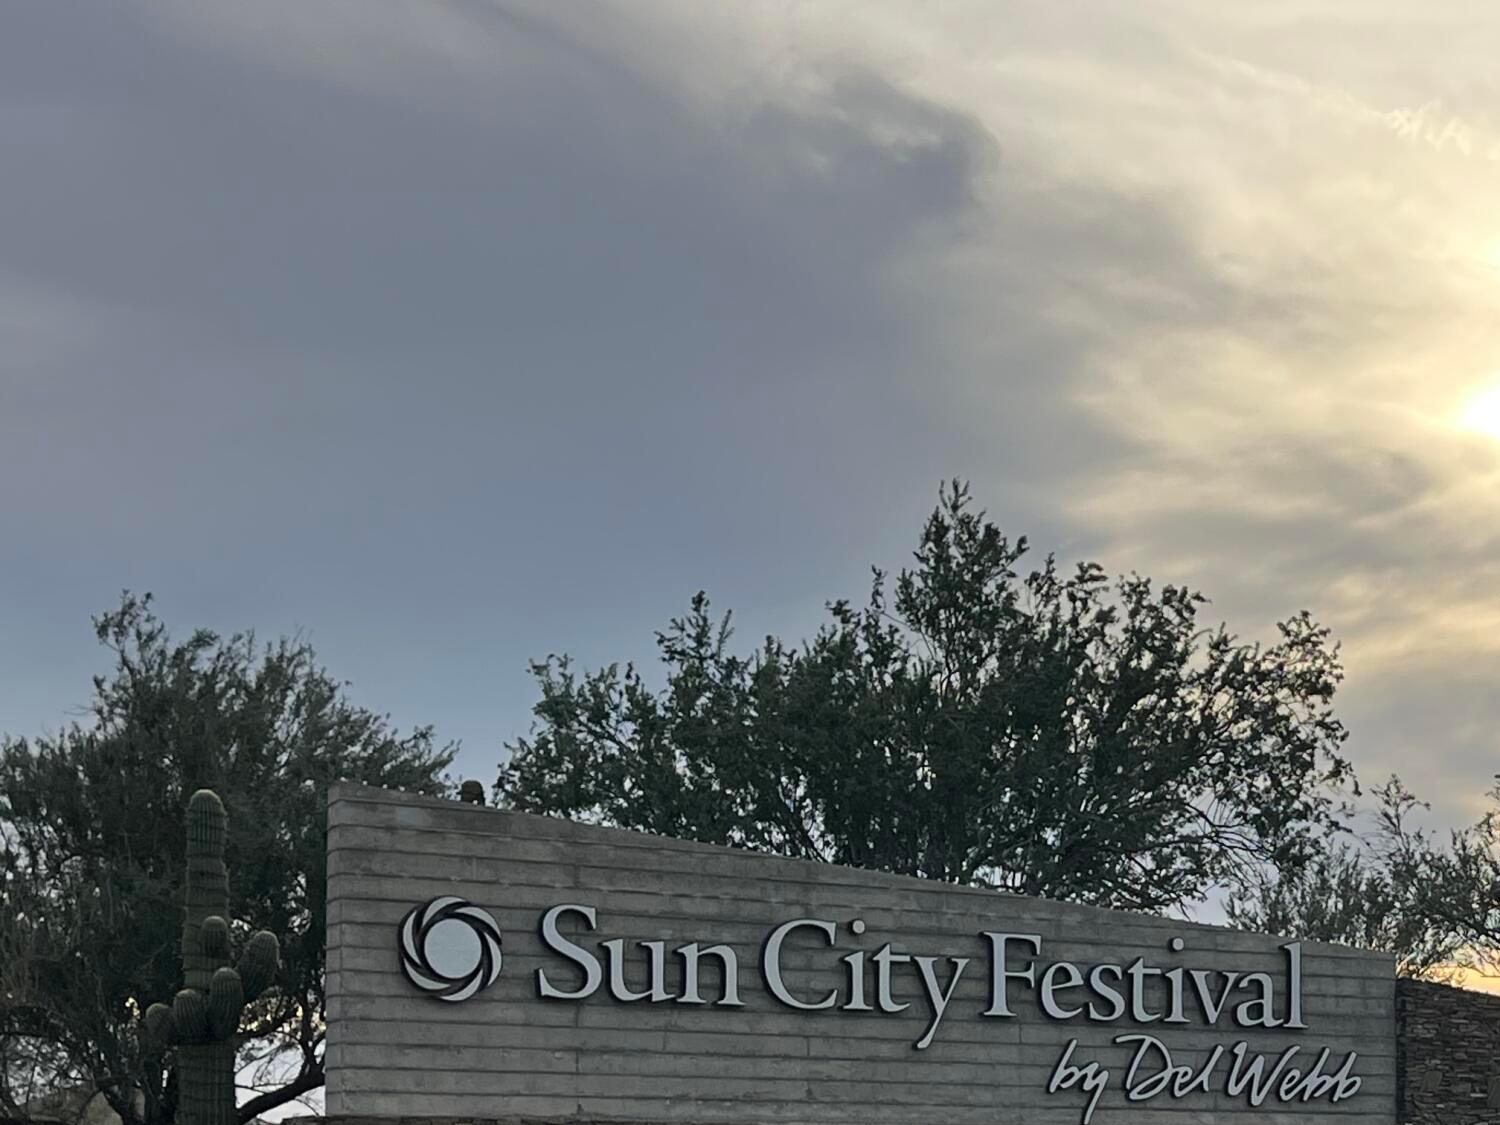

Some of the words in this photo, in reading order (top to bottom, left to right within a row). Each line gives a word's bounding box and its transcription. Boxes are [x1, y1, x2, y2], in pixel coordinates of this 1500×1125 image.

[539, 905, 746, 1006] Sun
[763, 919, 970, 1050] City
[982, 932, 1308, 1029] Festival
[1049, 1038, 1108, 1124] by
[1114, 1034, 1224, 1101] Del
[1225, 1040, 1362, 1107] Webb
